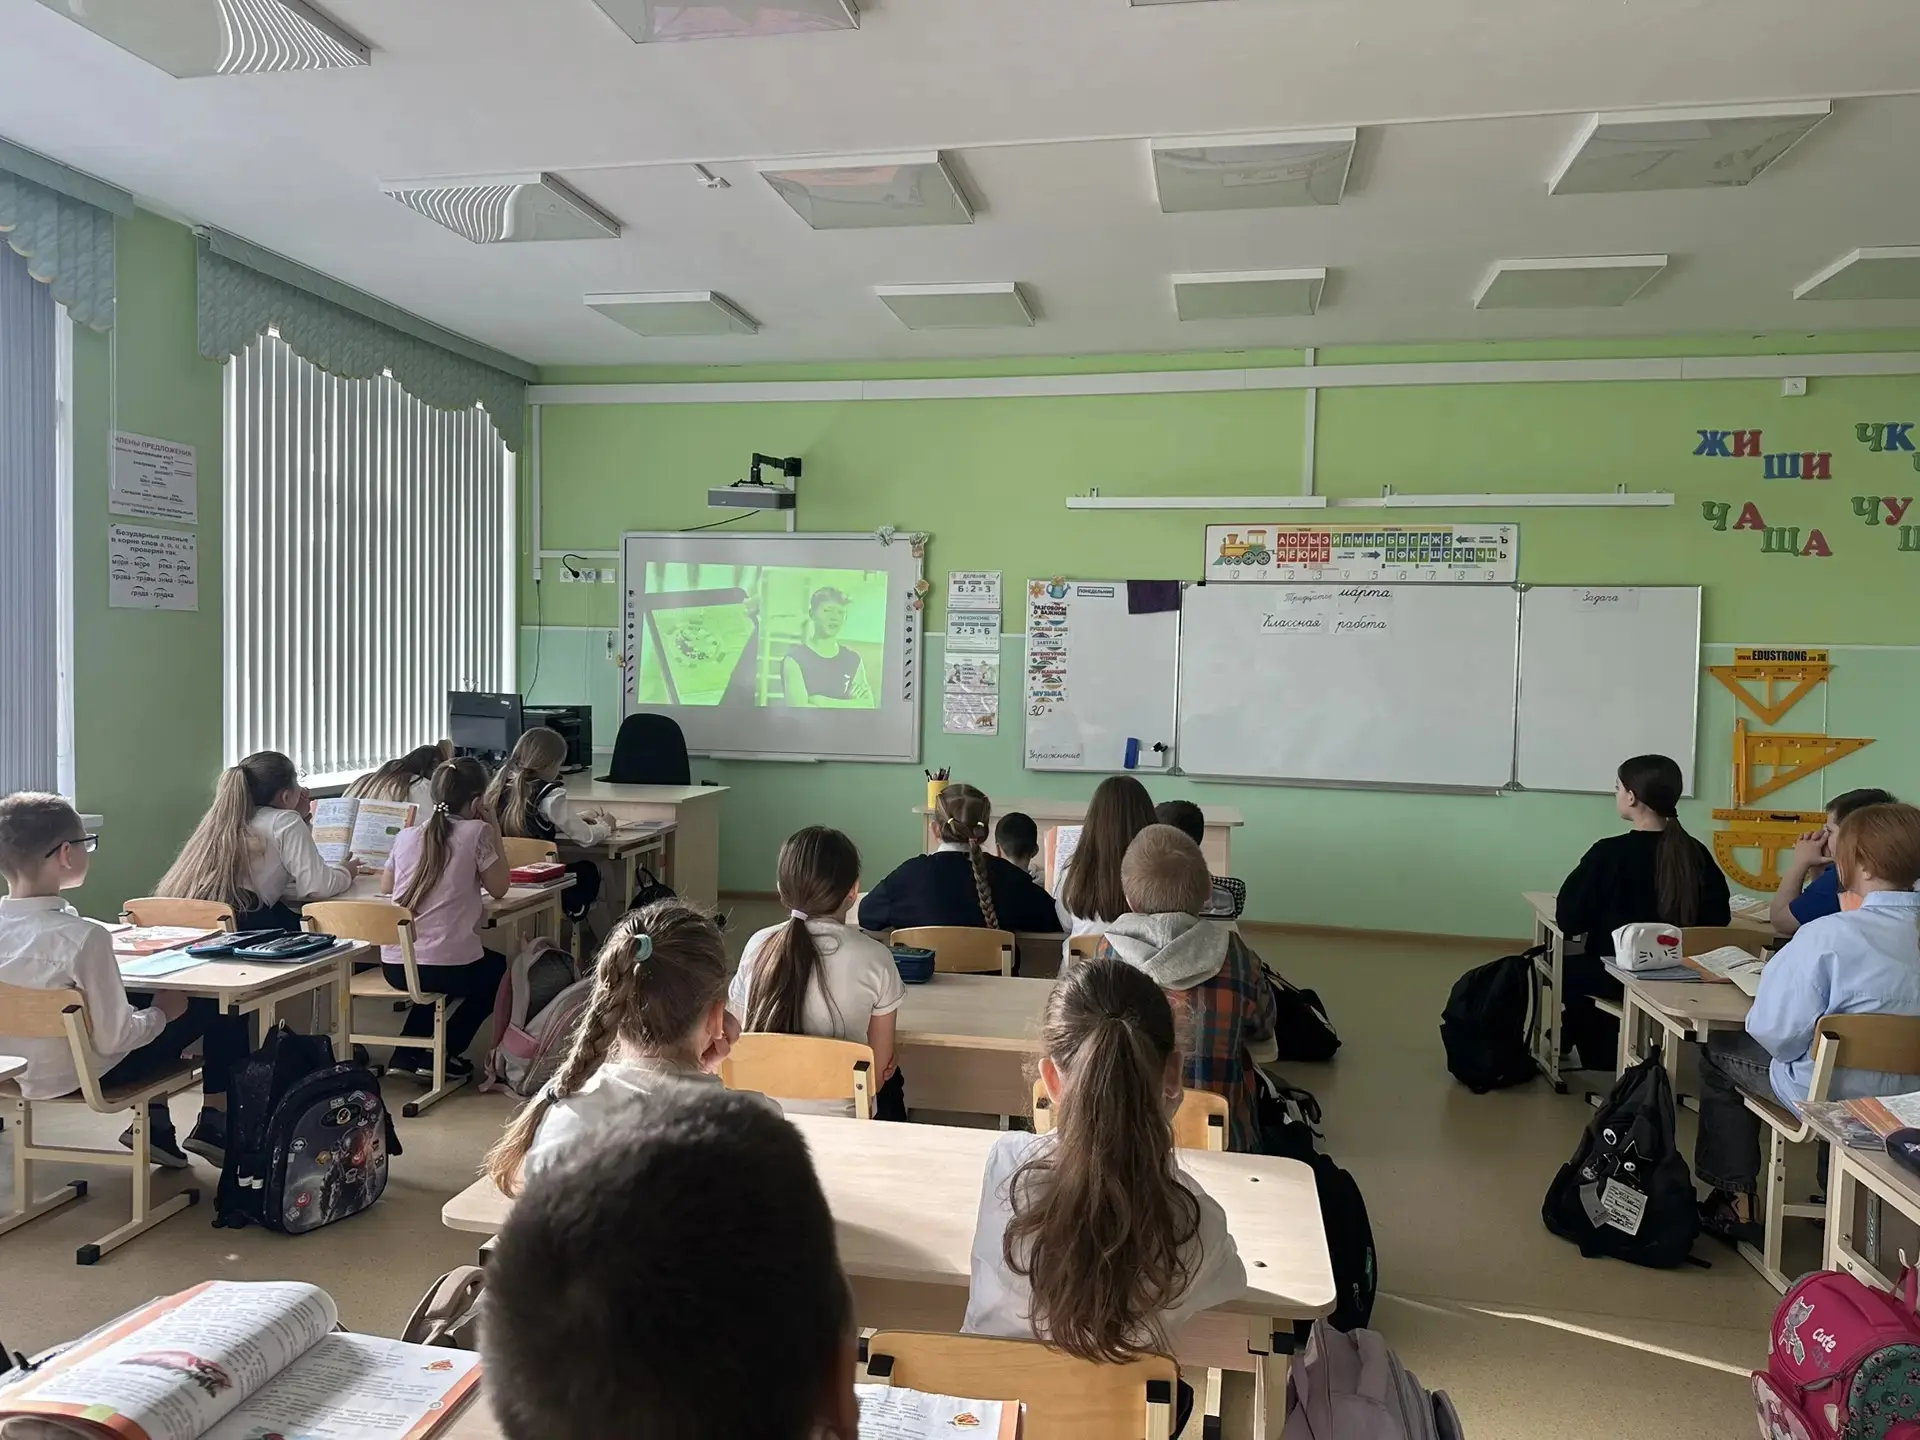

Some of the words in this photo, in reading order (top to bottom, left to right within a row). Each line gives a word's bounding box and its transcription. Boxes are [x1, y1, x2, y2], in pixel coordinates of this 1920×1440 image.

[141, 441, 192, 457] ПРЕДЛОЖЕНИЯ
[1693, 429, 1763, 457] ЖИ
[1854, 422, 1916, 452] ЧК
[1763, 452, 1832, 480] ШИ
[1702, 501, 1767, 531] ЧА
[1851, 496, 1913, 526] ЧУ
[116, 529, 160, 539] Безударные
[1761, 527, 1833, 557] ЩА
[985, 585, 991, 593] 3
[1263, 614, 1321, 628] Классная
[1335, 616, 1387, 633] работа
[1028, 749, 1080, 763] Упражнение
[1812, 1328, 1836, 1353] Cute
